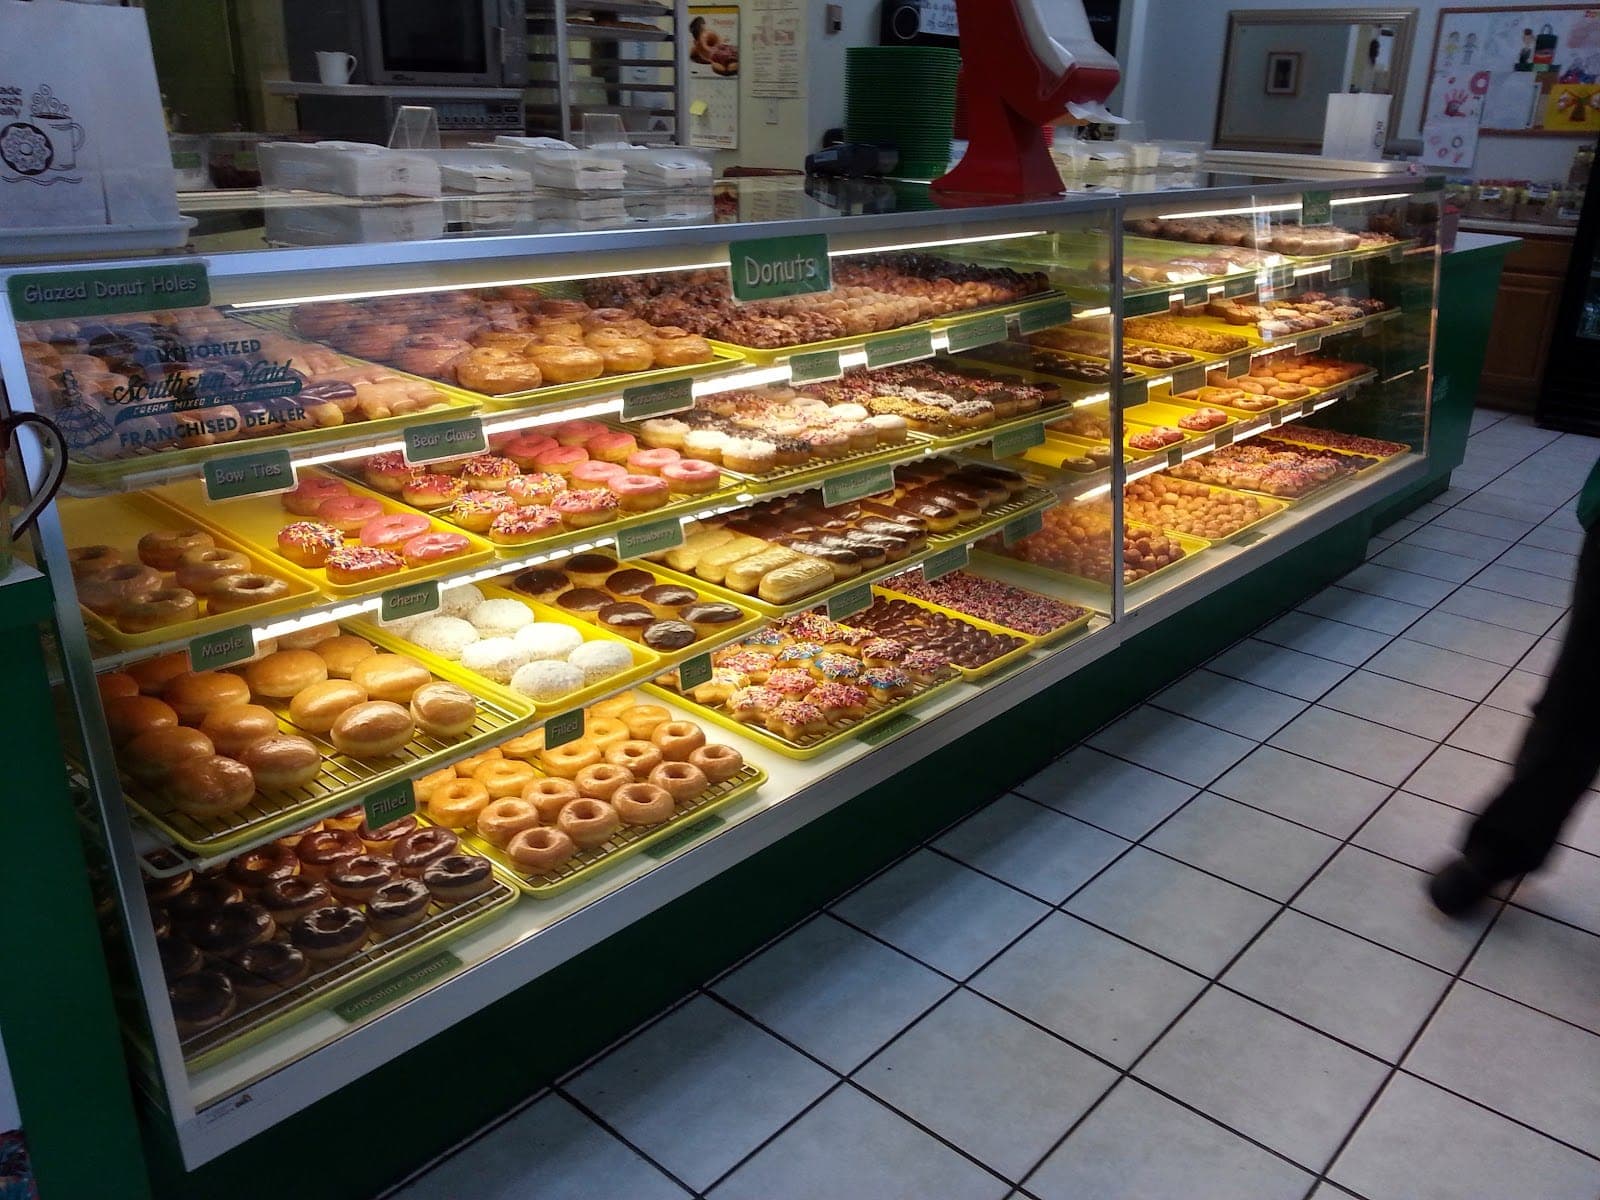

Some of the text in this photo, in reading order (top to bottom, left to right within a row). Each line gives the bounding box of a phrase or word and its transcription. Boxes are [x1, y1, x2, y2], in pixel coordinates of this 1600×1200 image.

[744, 253, 816, 286] Donuts
[24, 276, 197, 302] Glazed Donut Holes
[111, 358, 293, 404] Southern Maid
[133, 402, 168, 416] CREAM
[175, 397, 206, 411] MIXED
[120, 408, 306, 448] FRANCHISED DEALER
[411, 429, 476, 448] Bear Claws
[215, 461, 281, 486] Bow Ties
[625, 527, 675, 547] Strawberry
[389, 590, 430, 609] Cherry
[201, 637, 244, 657] Maple
[551, 719, 578, 740] Filled
[371, 792, 407, 818] Filled
